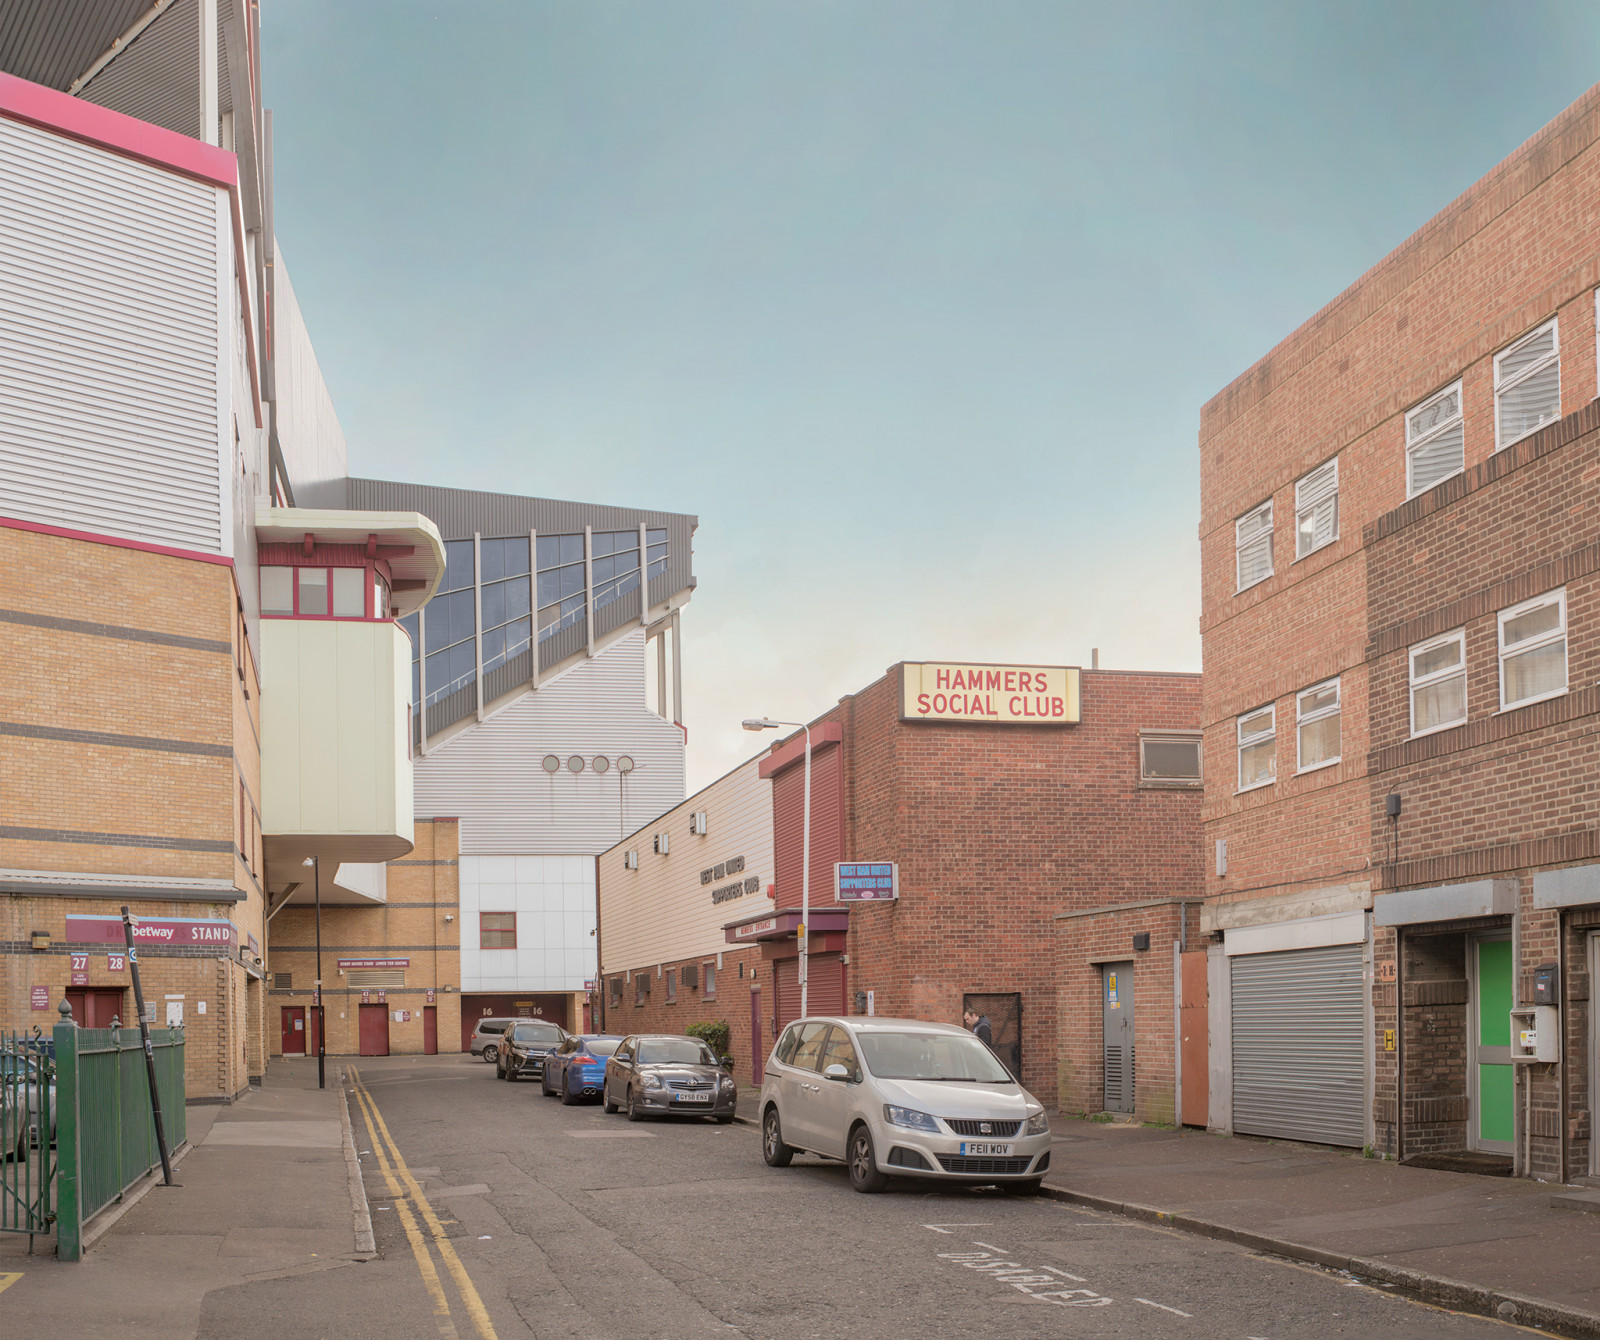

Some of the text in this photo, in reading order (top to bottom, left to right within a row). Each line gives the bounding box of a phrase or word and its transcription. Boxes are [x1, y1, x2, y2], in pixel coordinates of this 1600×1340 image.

[937, 668, 1048, 693] HAMMERS
[917, 693, 1065, 717] SOCIAL CLUB
[840, 865, 891, 876] WEST HAM UNITED
[840, 878, 892, 889] SUPPORTERS CLUB
[132, 925, 174, 940] betway
[191, 926, 230, 940] STAND
[73, 957, 87, 969] 27
[110, 957, 123, 969] 28
[483, 1007, 493, 1016] 16
[533, 1007, 543, 1015] 16
[1385, 1031, 1394, 1049] H
[970, 1144, 1008, 1154] FE11 WOV
[937, 1252, 1114, 1307] DISABLED
